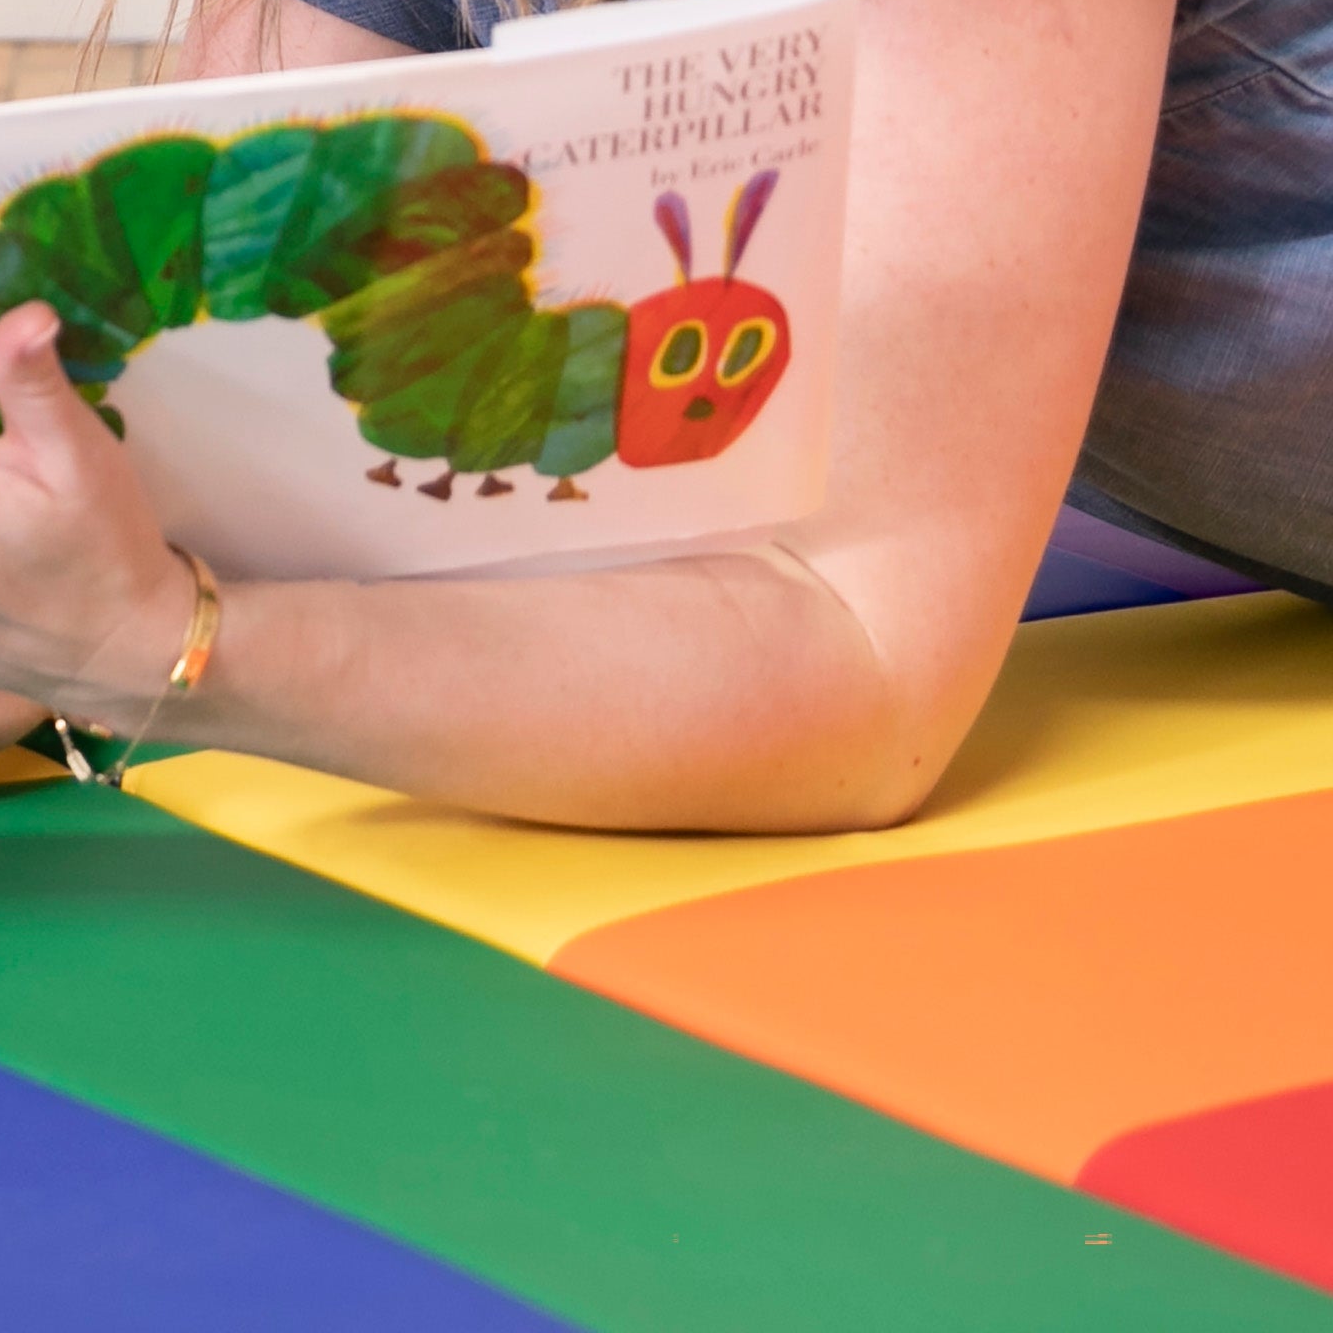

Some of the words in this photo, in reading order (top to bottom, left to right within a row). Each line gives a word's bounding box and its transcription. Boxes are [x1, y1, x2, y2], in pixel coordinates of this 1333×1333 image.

[614, 55, 707, 95] THE
[719, 27, 824, 71] VERY
[643, 64, 824, 123] HUNGRY
[521, 93, 823, 170] CATERPILLAR
[651, 164, 680, 190] by
[691, 155, 736, 185] Eric
[750, 138, 821, 167] Carle
